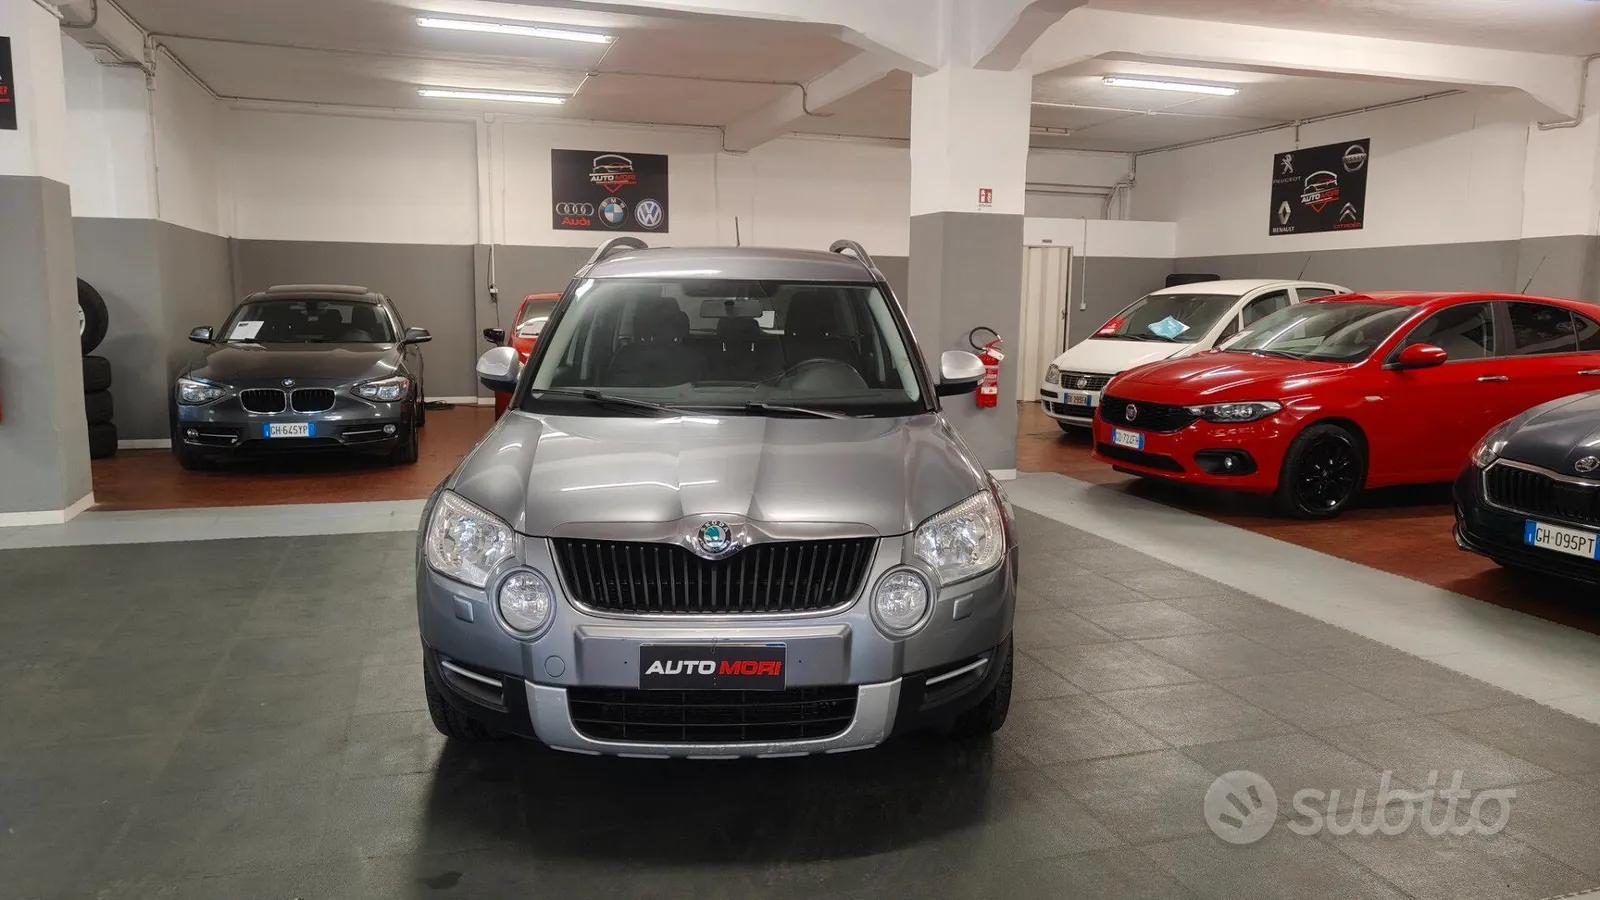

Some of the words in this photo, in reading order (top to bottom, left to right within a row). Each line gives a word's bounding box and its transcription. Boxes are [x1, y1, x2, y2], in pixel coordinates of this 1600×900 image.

[1301, 194, 1320, 203] AUTO
[1536, 528, 1550, 544] GH
[1555, 532, 1595, 553] 095PT
[645, 660, 716, 675] AUTO
[719, 661, 782, 676] MORI
